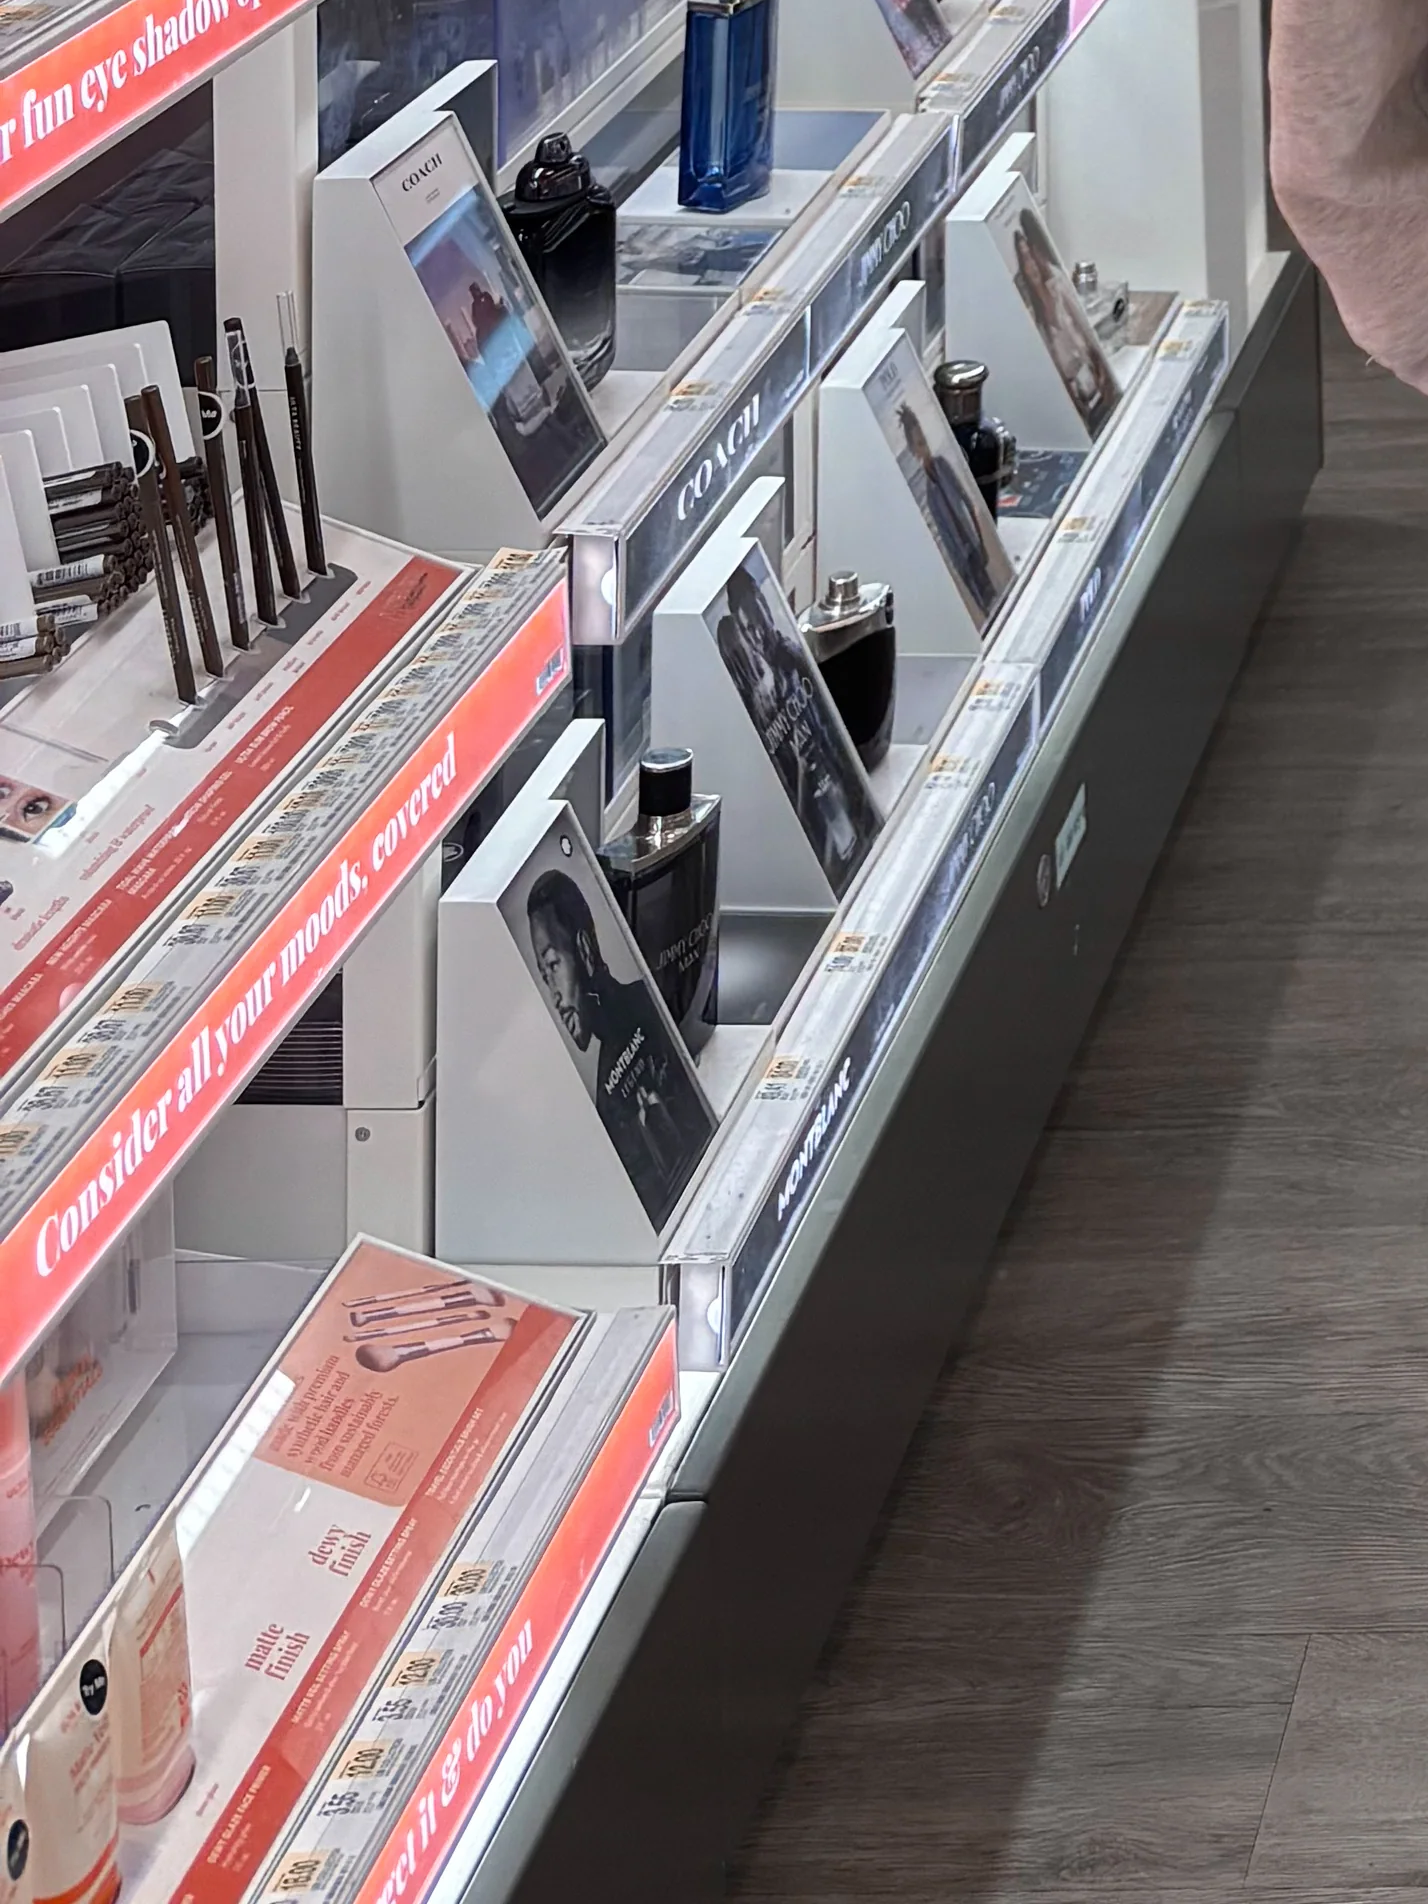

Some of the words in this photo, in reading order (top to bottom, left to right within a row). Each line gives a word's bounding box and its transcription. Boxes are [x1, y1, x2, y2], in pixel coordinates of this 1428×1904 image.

[22, 82, 75, 148] fun
[80, 48, 127, 113] eye
[402, 153, 442, 191] COACH
[677, 393, 760, 520] COACH
[35, 1097, 183, 1278] Consider
[176, 1028, 211, 1113] all
[214, 961, 276, 1073] your
[371, 731, 457, 872] covered
[604, 1028, 645, 1095] MONTBLANC
[778, 1057, 851, 1221] MONTBLANC
[315, 1385, 336, 1413] hair
[333, 1371, 350, 1396] and
[325, 1398, 355, 1439] handles
[308, 1523, 346, 1566] dewy
[328, 1531, 371, 1577] finish
[244, 1623, 285, 1673] matte
[263, 1631, 310, 1682] finish
[419, 1790, 436, 1852] it
[441, 1737, 462, 1808] &
[466, 1695, 493, 1762] do
[495, 1619, 533, 1720] you
